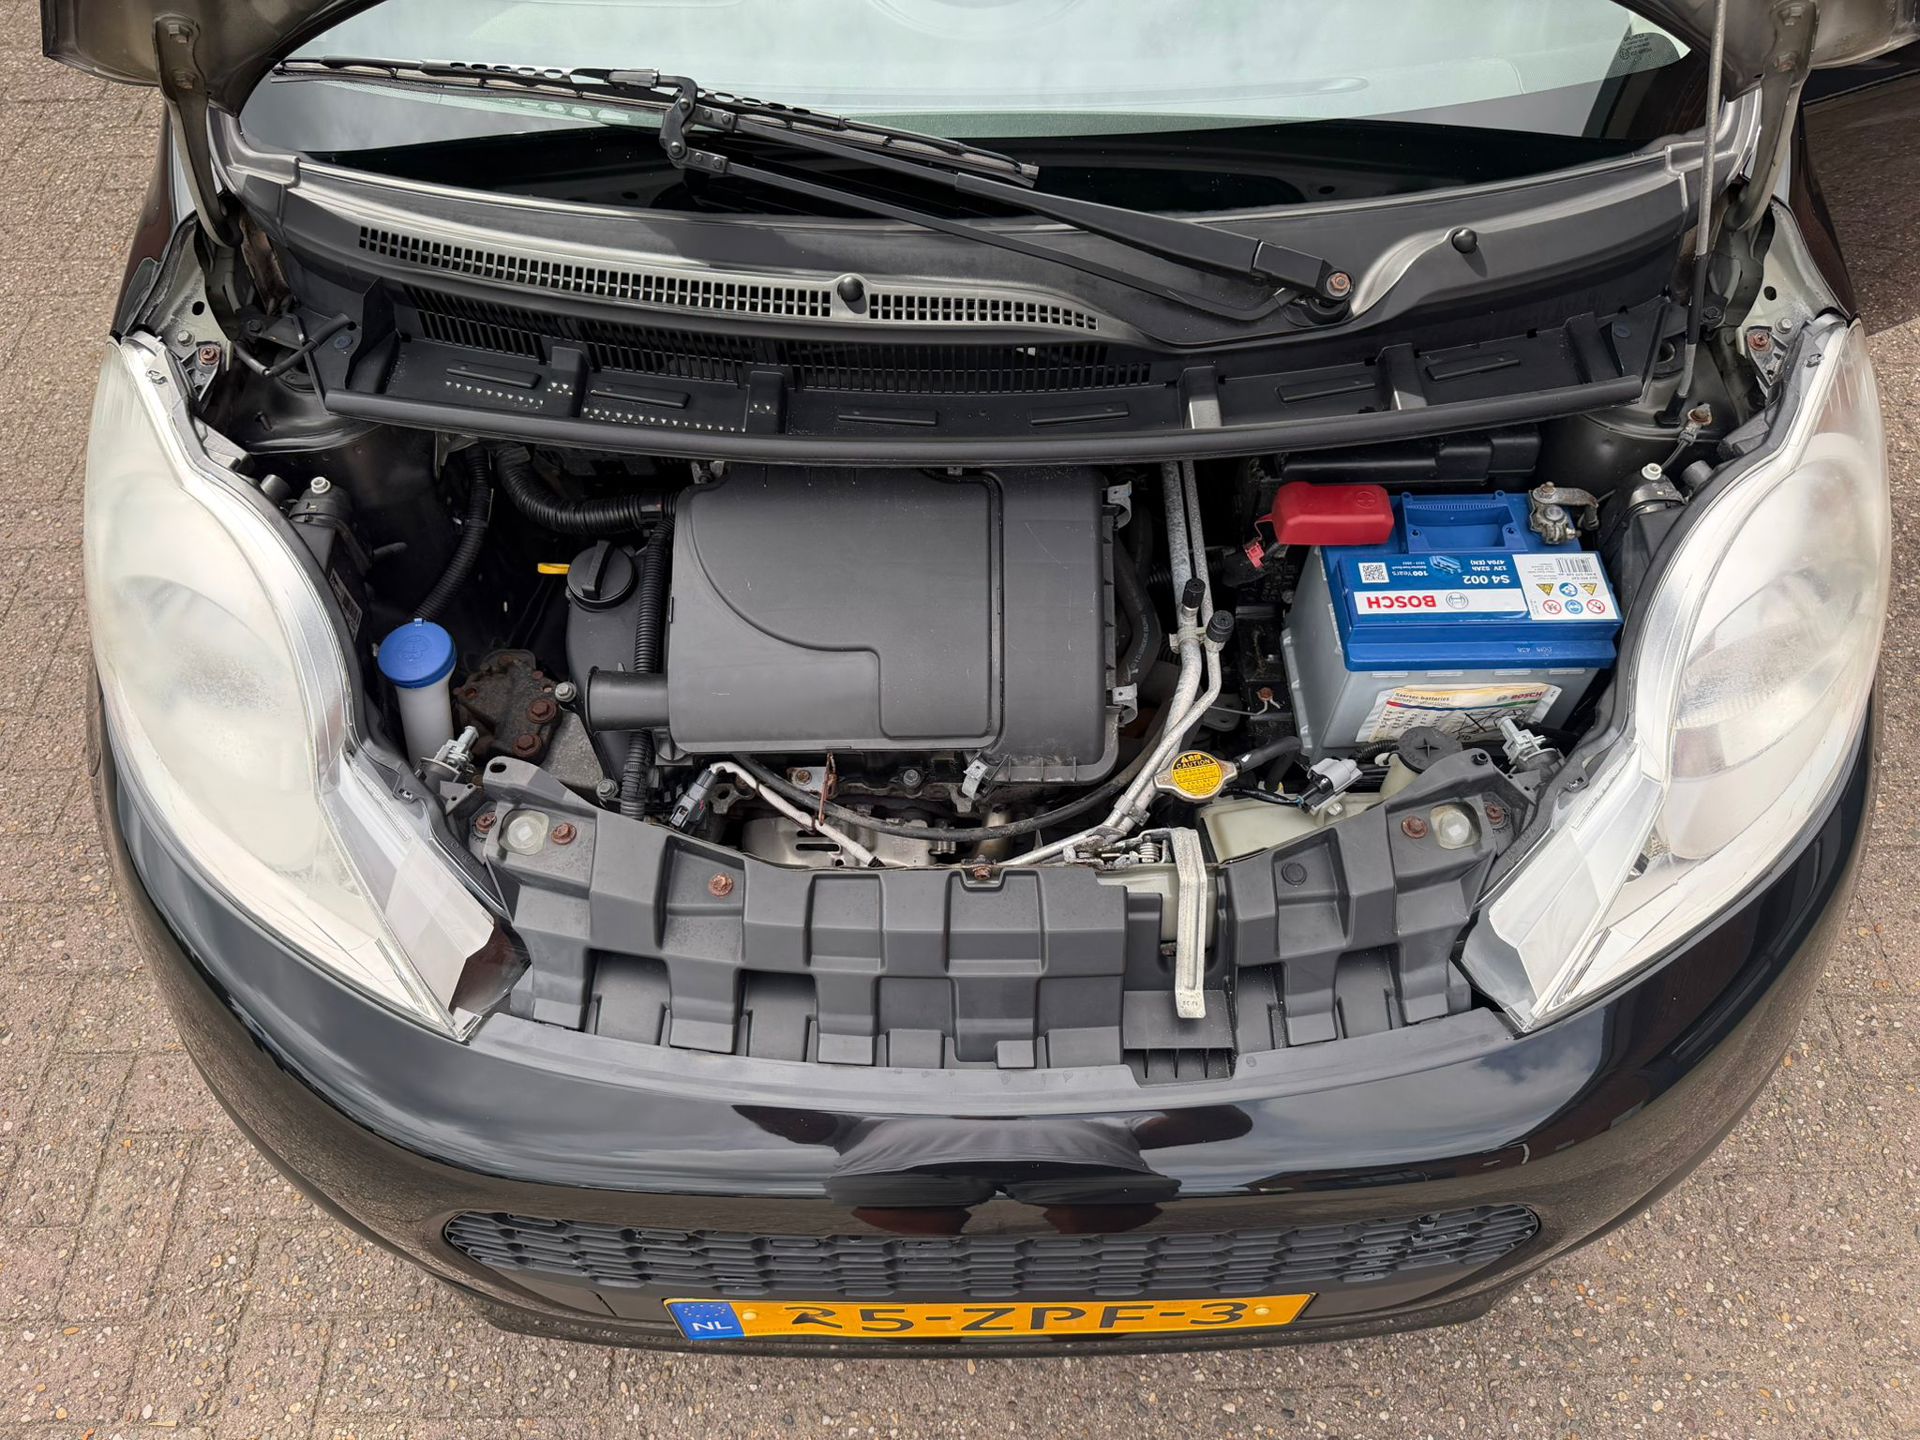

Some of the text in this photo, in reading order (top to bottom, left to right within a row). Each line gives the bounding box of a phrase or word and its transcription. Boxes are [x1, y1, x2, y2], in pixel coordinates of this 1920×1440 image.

[1462, 574, 1510, 585] S4 002
[1366, 595, 1437, 609] BOSCH
[1511, 691, 1543, 700] BOSCH
[1176, 759, 1210, 769] CAUTION
[692, 1321, 734, 1331] NL
